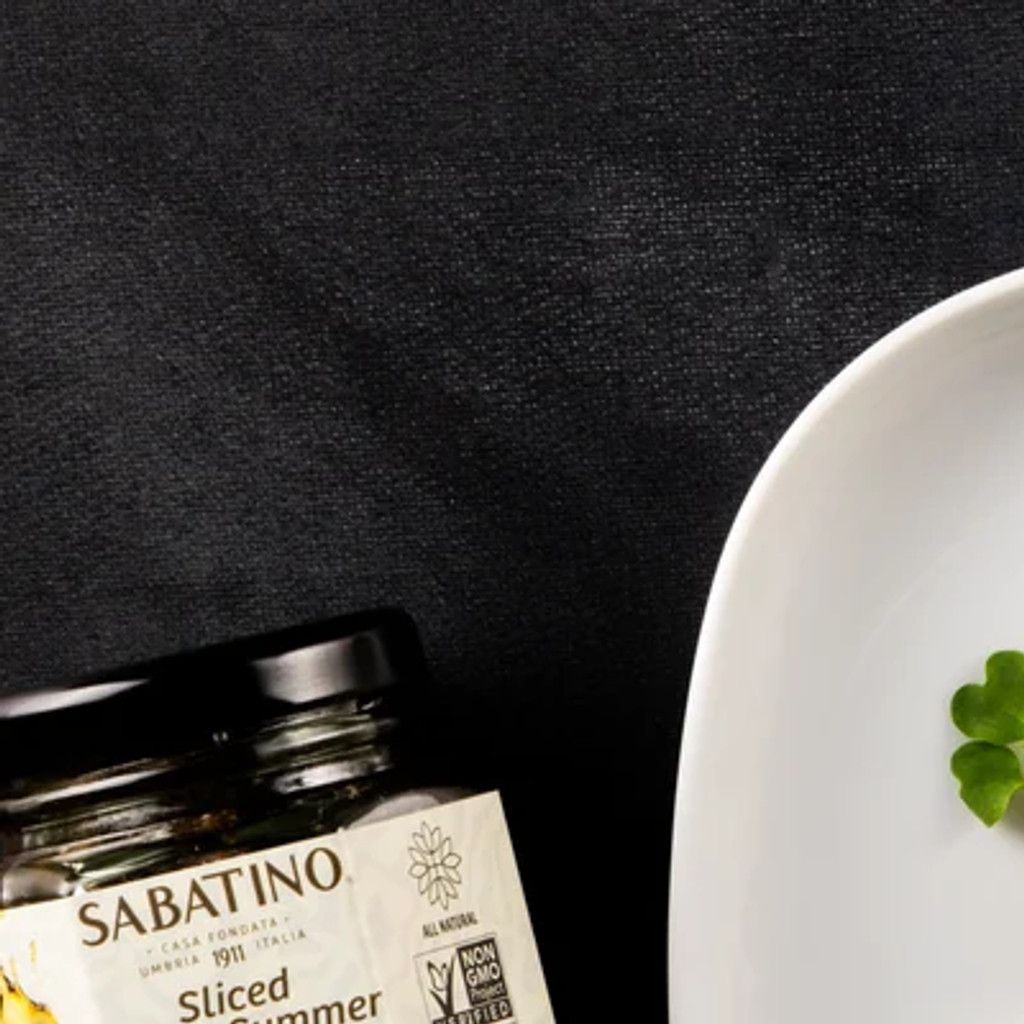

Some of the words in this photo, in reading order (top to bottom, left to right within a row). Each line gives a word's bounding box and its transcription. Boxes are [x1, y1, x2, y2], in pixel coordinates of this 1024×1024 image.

[78, 847, 342, 947] SABATINO
[161, 936, 200, 954] CASA
[208, 918, 277, 942] FONDATA
[422, 924, 439, 938] ALL
[439, 911, 478, 932] NATURAL
[139, 956, 199, 978] UMBRIA
[212, 944, 246, 968] 1911
[256, 929, 306, 949] ITALIA
[462, 942, 496, 968] NON
[466, 963, 501, 987] GMO
[178, 967, 289, 1023] Sliced
